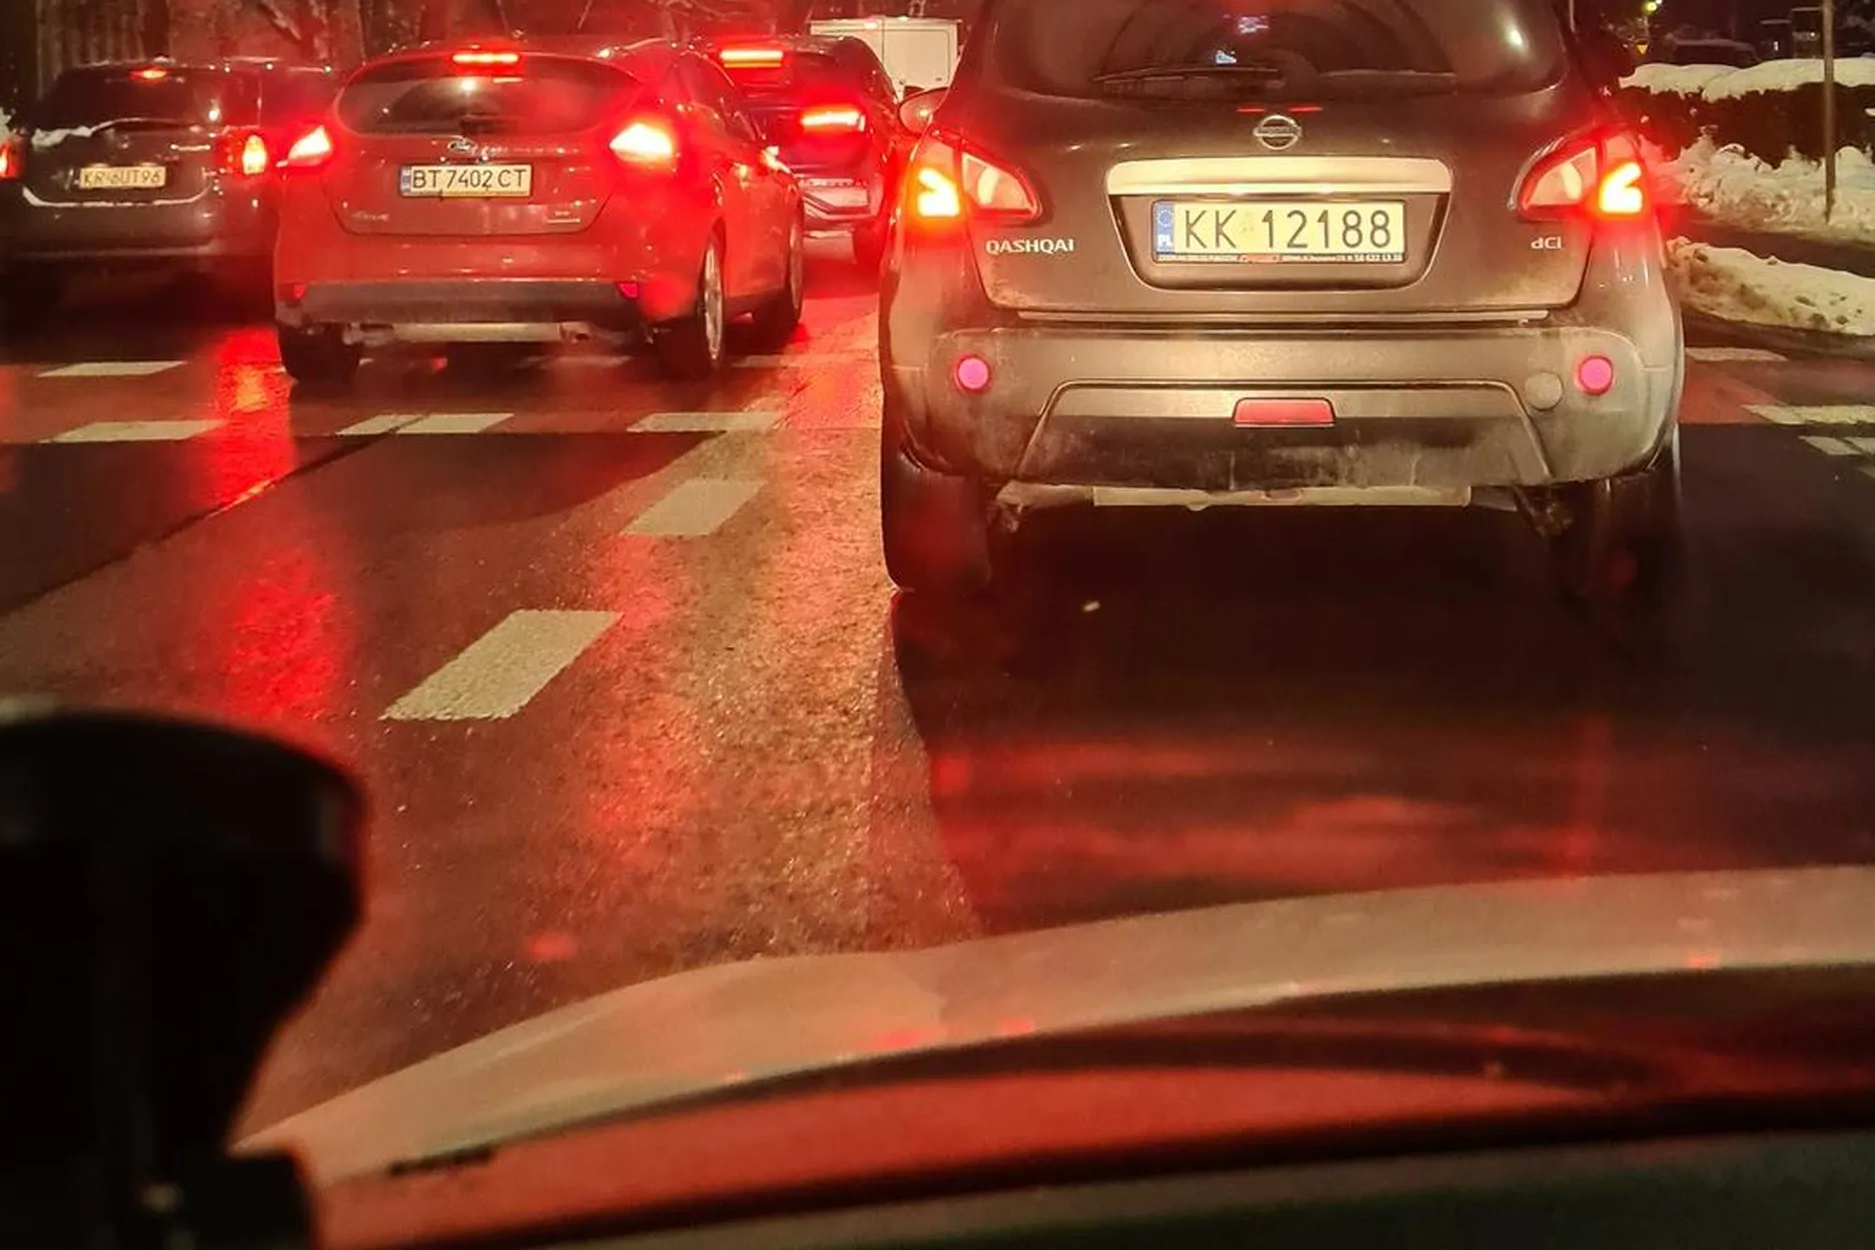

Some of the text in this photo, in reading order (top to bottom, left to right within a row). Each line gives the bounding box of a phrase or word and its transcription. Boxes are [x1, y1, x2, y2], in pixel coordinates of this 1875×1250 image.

[412, 168, 527, 189] BT 7402 CT
[1185, 209, 1391, 248] KK 12188
[985, 238, 1074, 255] QASHQAI
[1158, 234, 1173, 246] PL
